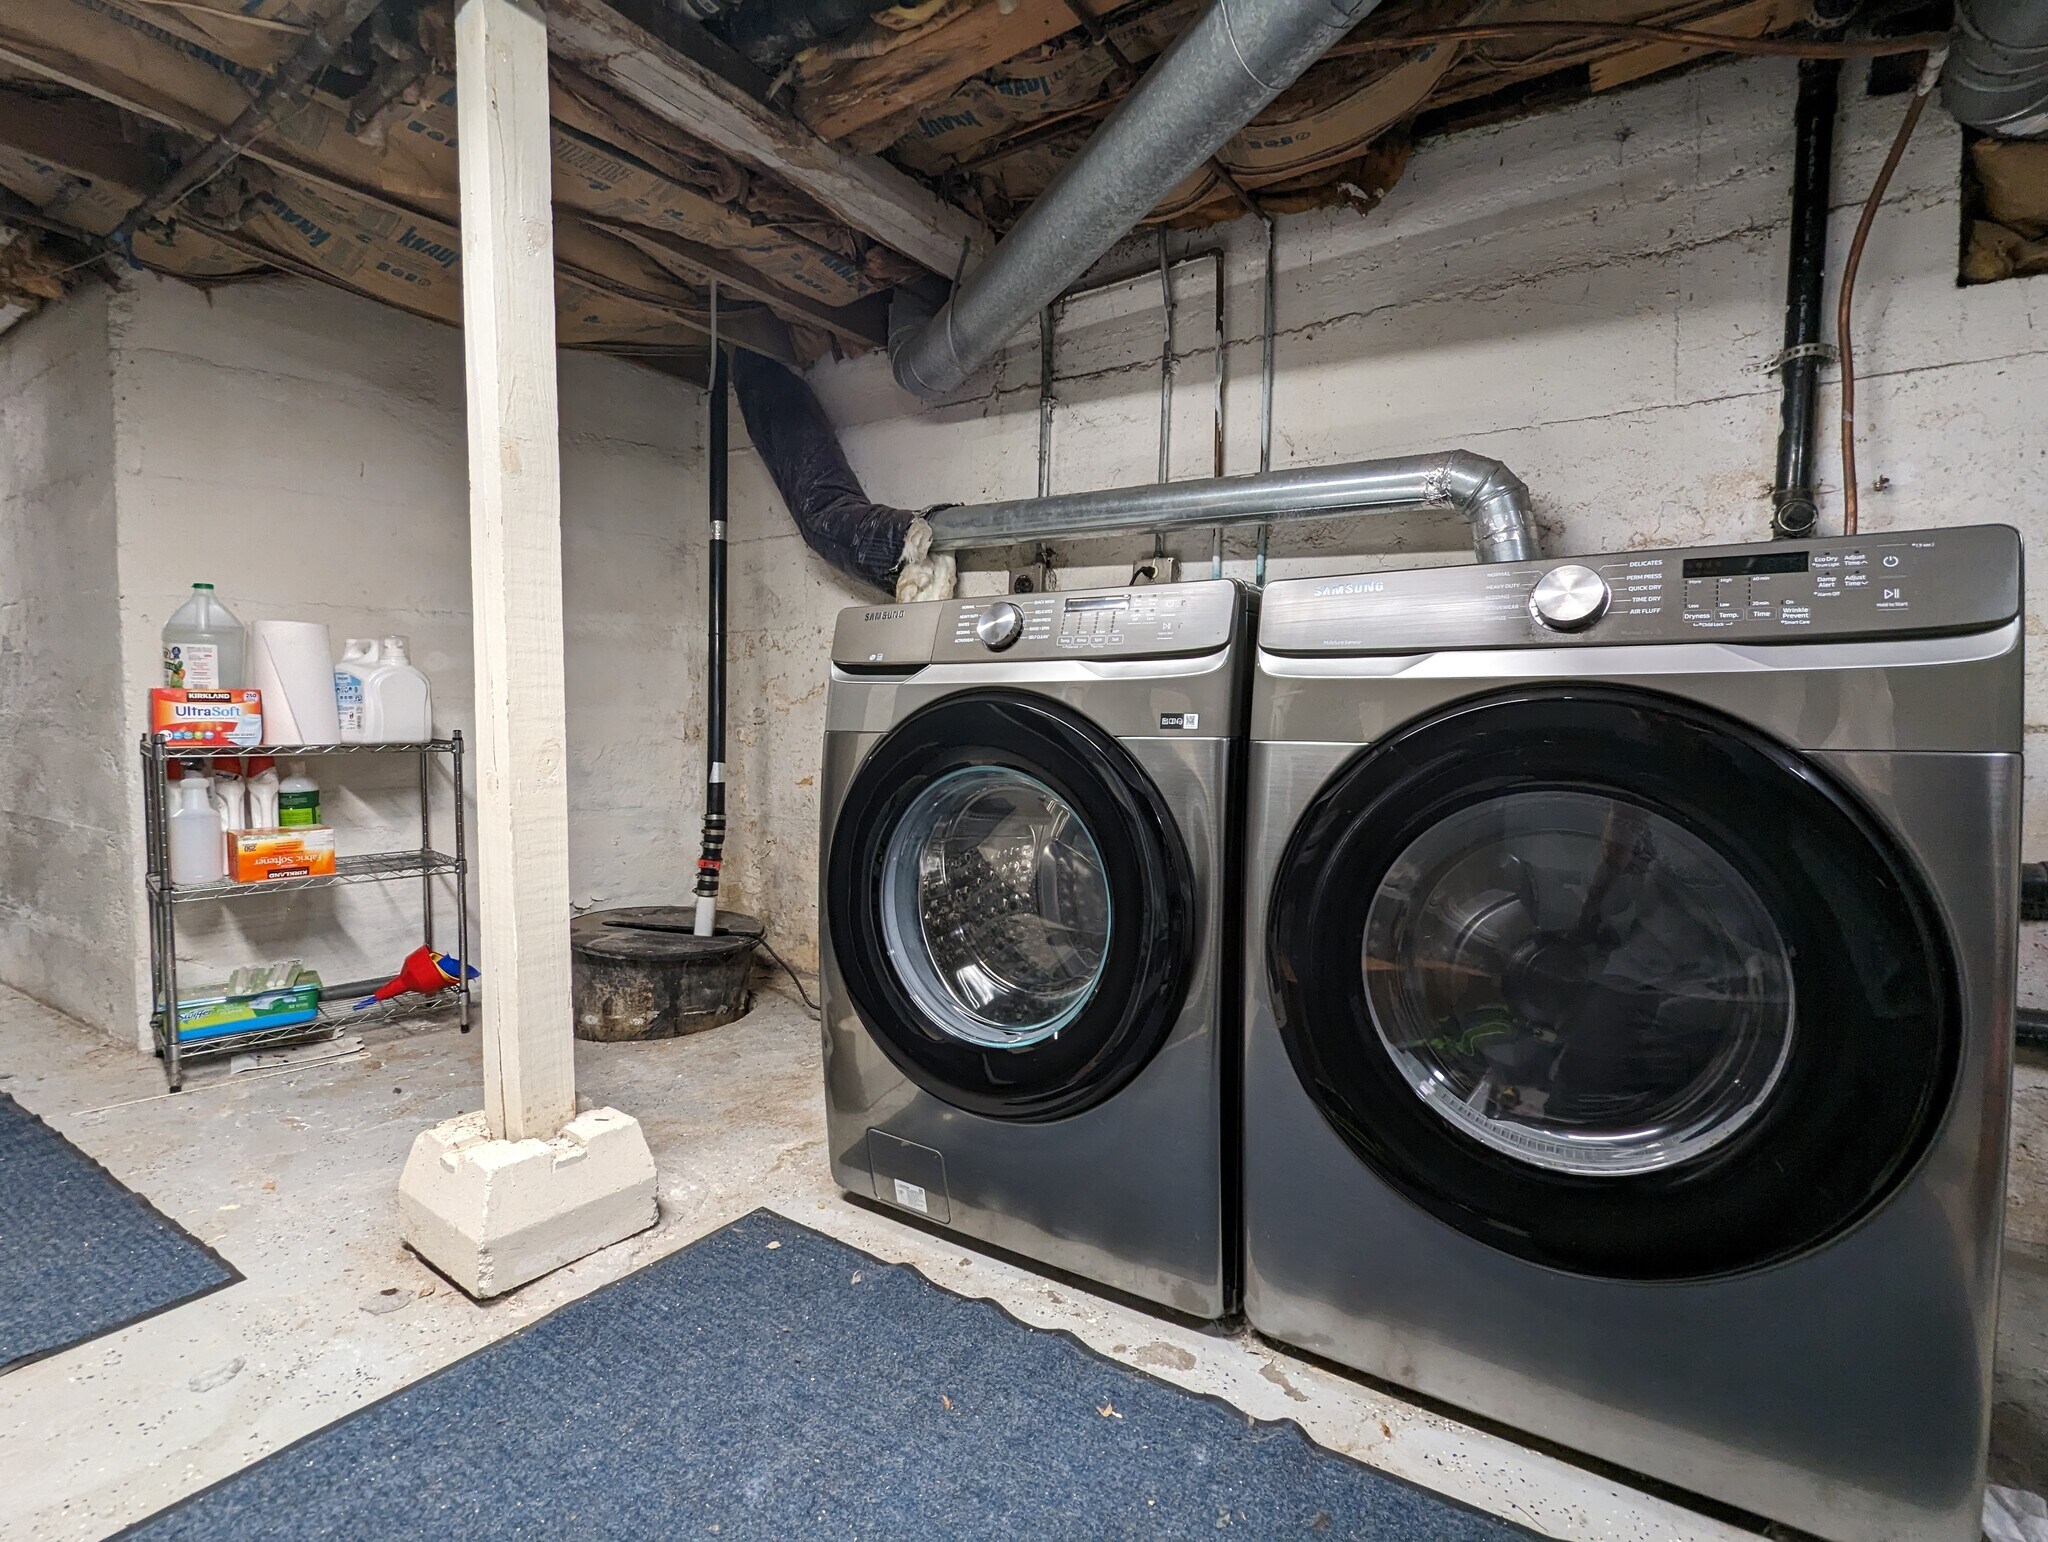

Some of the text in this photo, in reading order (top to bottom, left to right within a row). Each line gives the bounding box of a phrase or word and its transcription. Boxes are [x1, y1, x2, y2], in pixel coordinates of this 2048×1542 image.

[1630, 560, 1662, 568] DELICATES
[1314, 582, 1384, 597] SAMSUNG
[864, 610, 905, 621] SAMSUNG
[176, 706, 240, 716] UltraSoft
[255, 856, 294, 866] Softener
[297, 854, 321, 862] Fabric
[269, 870, 307, 878] KIRKLAND
[178, 1009, 212, 1021] Swiffer
